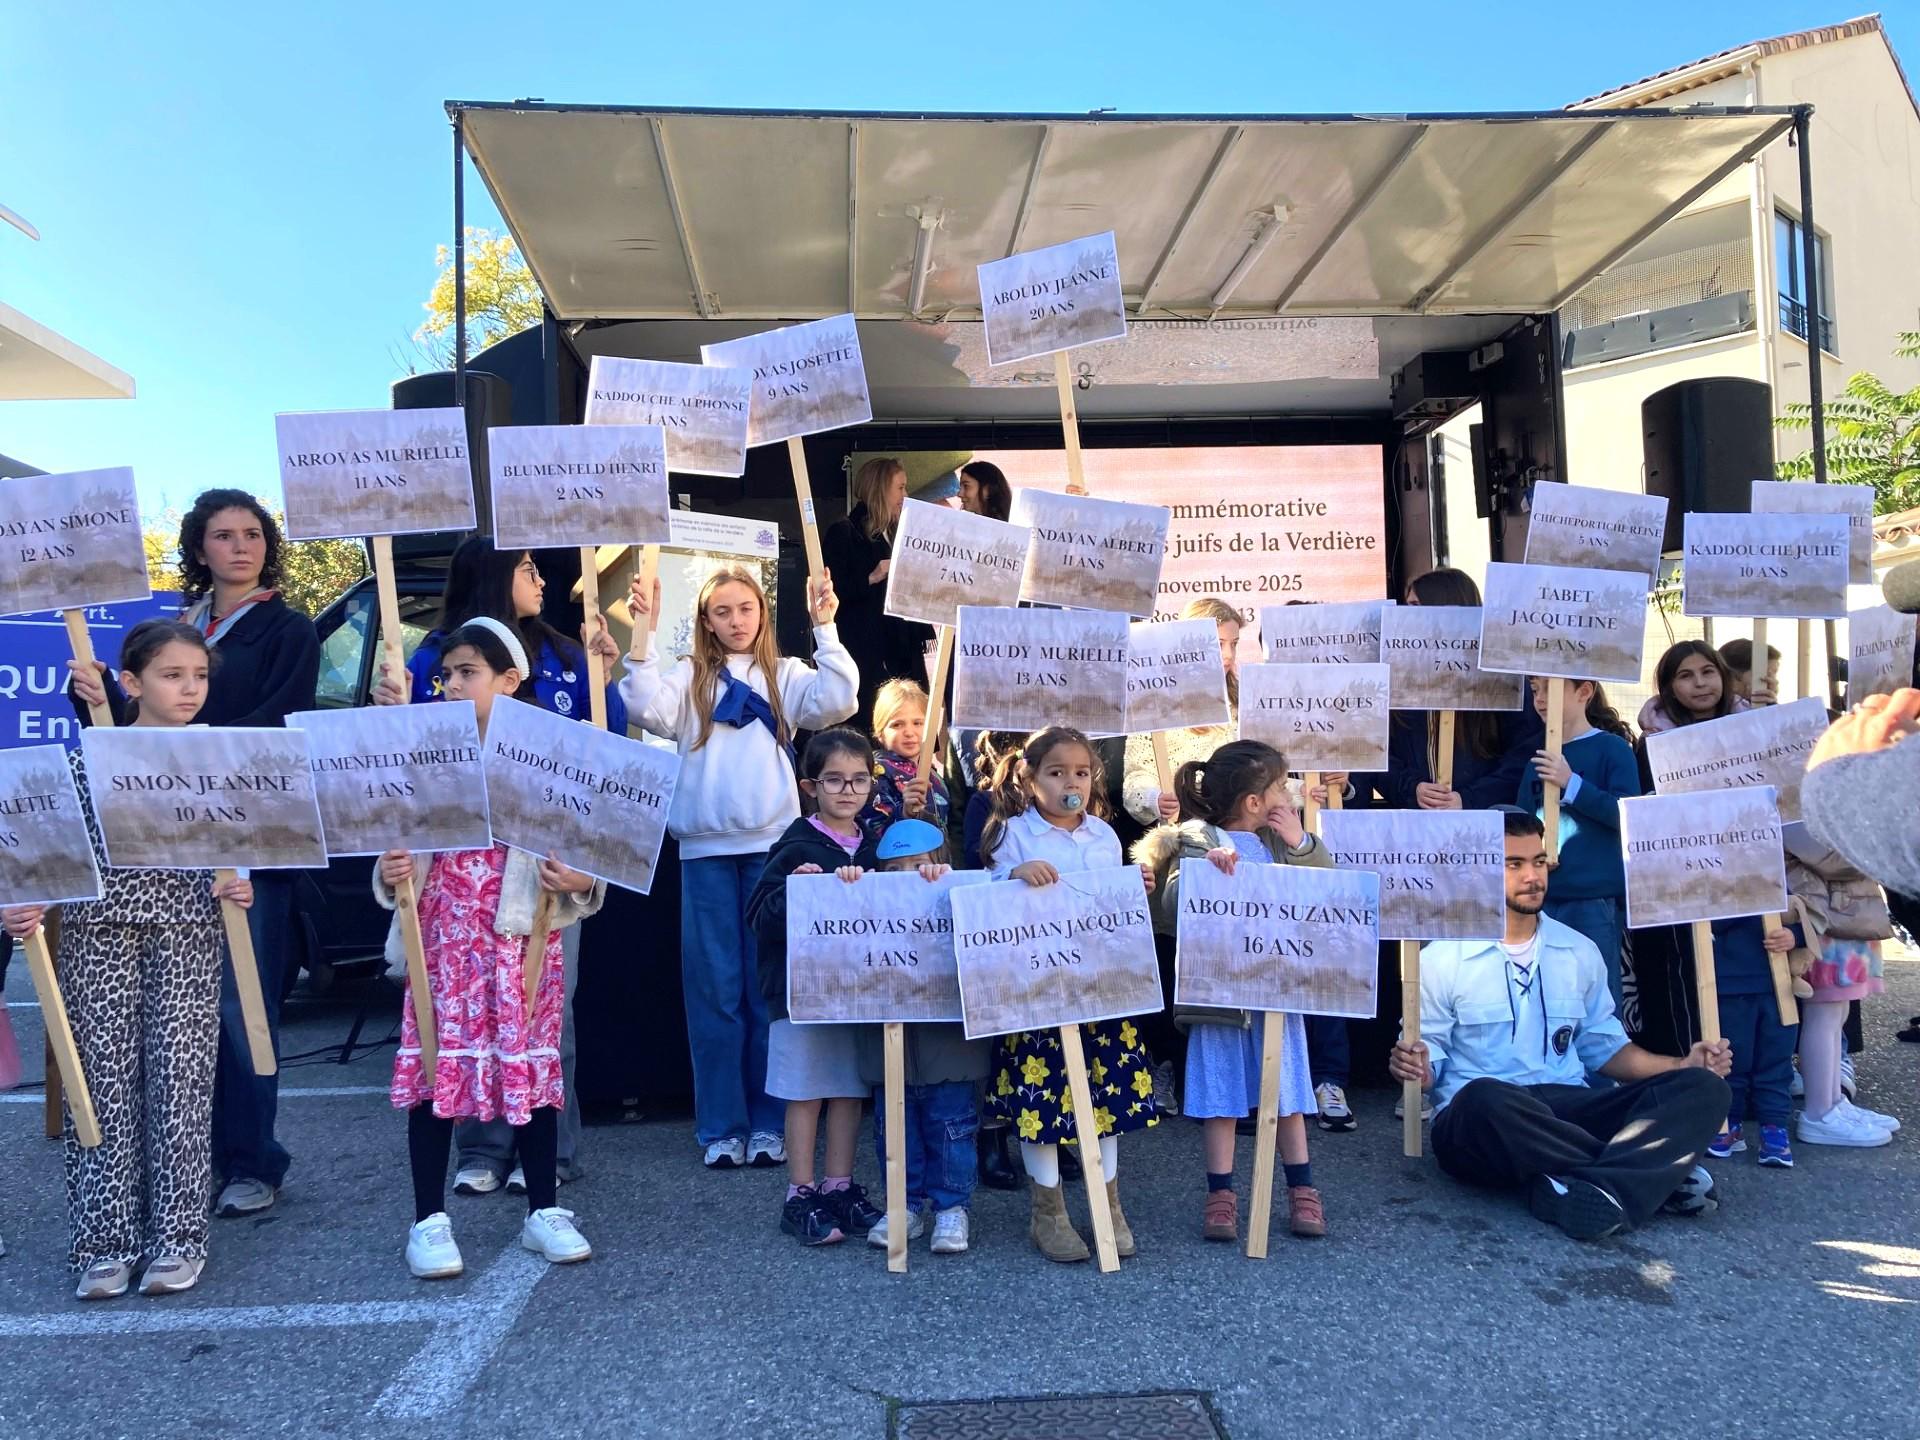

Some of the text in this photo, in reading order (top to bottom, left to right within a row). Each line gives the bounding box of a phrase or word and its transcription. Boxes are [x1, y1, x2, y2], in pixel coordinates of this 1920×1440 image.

[992, 267, 1110, 306] ABOUDY JEANNE
[1029, 300, 1075, 320] 20 ANS
[788, 348, 855, 377] JOSETTE
[768, 382, 809, 401] 9 ANS
[594, 390, 746, 412] KADDOUCHE ALPHONSE
[656, 415, 688, 428] ANS
[286, 446, 466, 468] ARROVAS MURIELLE
[503, 462, 657, 477] BLUMENFELD HENRI
[354, 474, 408, 490] 11 ANS
[556, 486, 604, 501] 2 ANS
[60, 509, 131, 530] SIMONE
[1533, 512, 1662, 539] CHICHEPORTICHE REINE
[1100, 538, 1157, 556] ALBERT
[1172, 533, 1223, 559] juifs
[1228, 532, 1254, 552] de
[1260, 532, 1281, 552] la
[1285, 531, 1376, 551] Verdière
[1577, 535, 1609, 548] 5 ANS
[20, 543, 75, 563] 12 ANS
[903, 535, 1020, 573] TORDJMAN LOUISE
[1690, 544, 1841, 560] KADDOUCHE JULIE
[1072, 556, 1105, 571] ANS
[1740, 566, 1789, 578] 10 ANS
[939, 568, 975, 586] 7 ANS
[1157, 574, 1303, 595] novembre 2025
[1538, 586, 1594, 604] TABET
[1508, 609, 1618, 631] JACQUELINE
[1275, 633, 1355, 649] BLUMENFELD
[1383, 639, 1448, 650] ARROVAS
[1535, 637, 1586, 652] 15 ANS
[960, 643, 1127, 663] ABOUDY MURIELLE
[1159, 651, 1207, 667] ALBERT
[1323, 654, 1350, 664] ANS
[1434, 660, 1471, 673] 7 ANS
[1016, 671, 1068, 688] 13 ANS
[1138, 675, 1178, 691] MOIS
[1256, 697, 1373, 713] ATTAS JACQUES
[1293, 721, 1335, 733] 2 ANS
[311, 753, 405, 772] LUMENFELD
[1658, 750, 1767, 785] CHICHEPORTICHE
[495, 741, 662, 809] KADDOUCHE JOSEPH
[1734, 770, 1765, 786] ANS
[112, 774, 295, 795] SIMON JEANINE
[365, 781, 415, 799] 4 ANS
[543, 787, 592, 816] 3 ANS
[174, 805, 247, 823] 10 ANS
[1627, 826, 1779, 854] CHICHEPORTICHE GUY
[1405, 852, 1502, 865] GEORGETTE
[1684, 857, 1723, 871] 8 ANS
[1385, 876, 1434, 891] 3 ANS
[1183, 897, 1376, 927] ABOUDY SUZANNE
[809, 918, 907, 936] ARROVAS
[959, 909, 1146, 949] TORDJMAN JACQUES
[1243, 935, 1314, 958] 16 ANS
[863, 950, 919, 967] 4 ANS
[1030, 948, 1082, 971] 5 ANS
